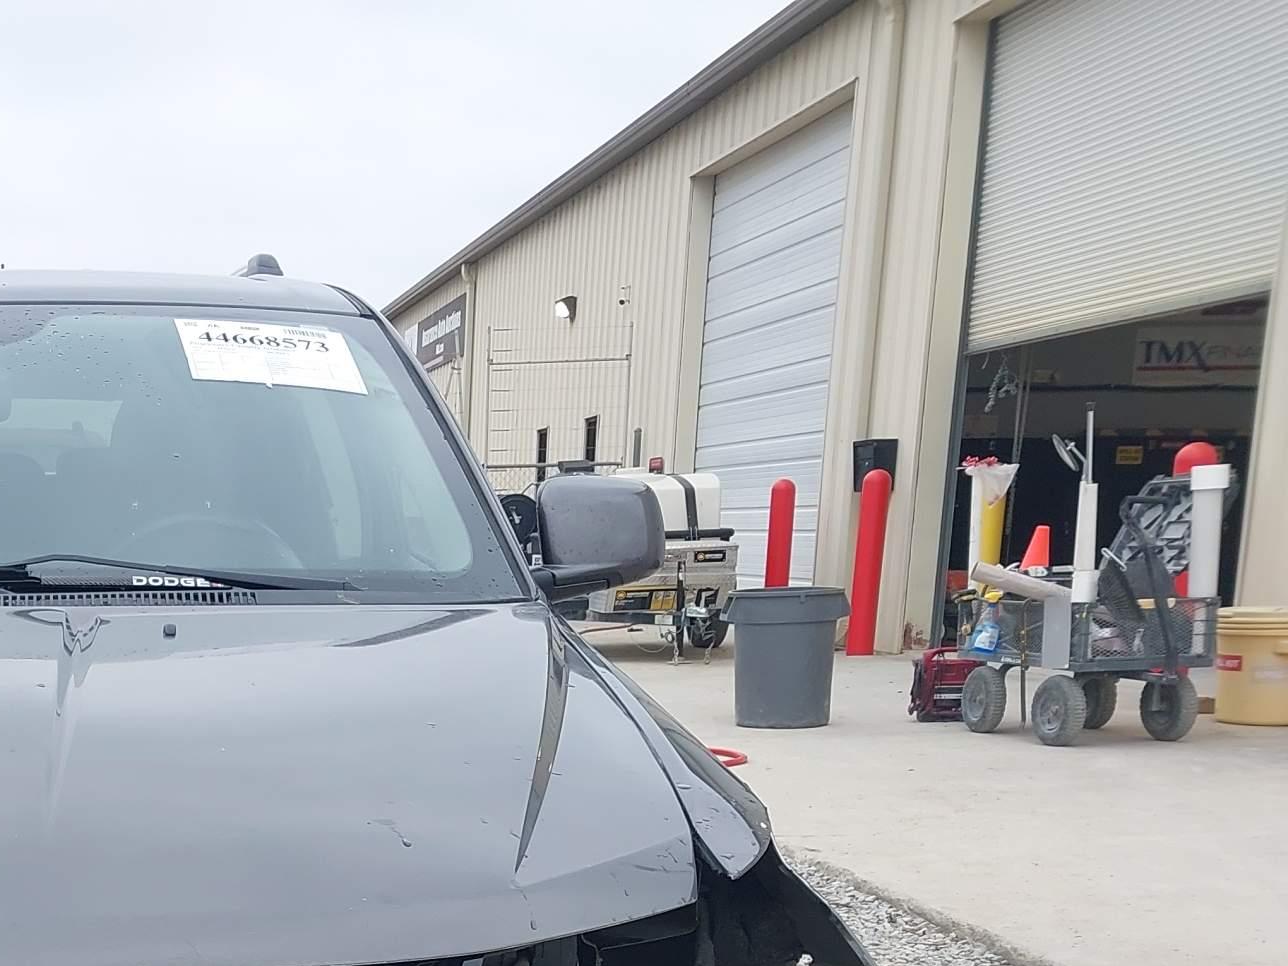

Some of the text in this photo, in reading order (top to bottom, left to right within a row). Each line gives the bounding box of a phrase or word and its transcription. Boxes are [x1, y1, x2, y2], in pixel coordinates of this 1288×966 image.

[198, 331, 330, 353] 44668573
[1140, 340, 1208, 372] TMX
[132, 575, 211, 588] DODGE
